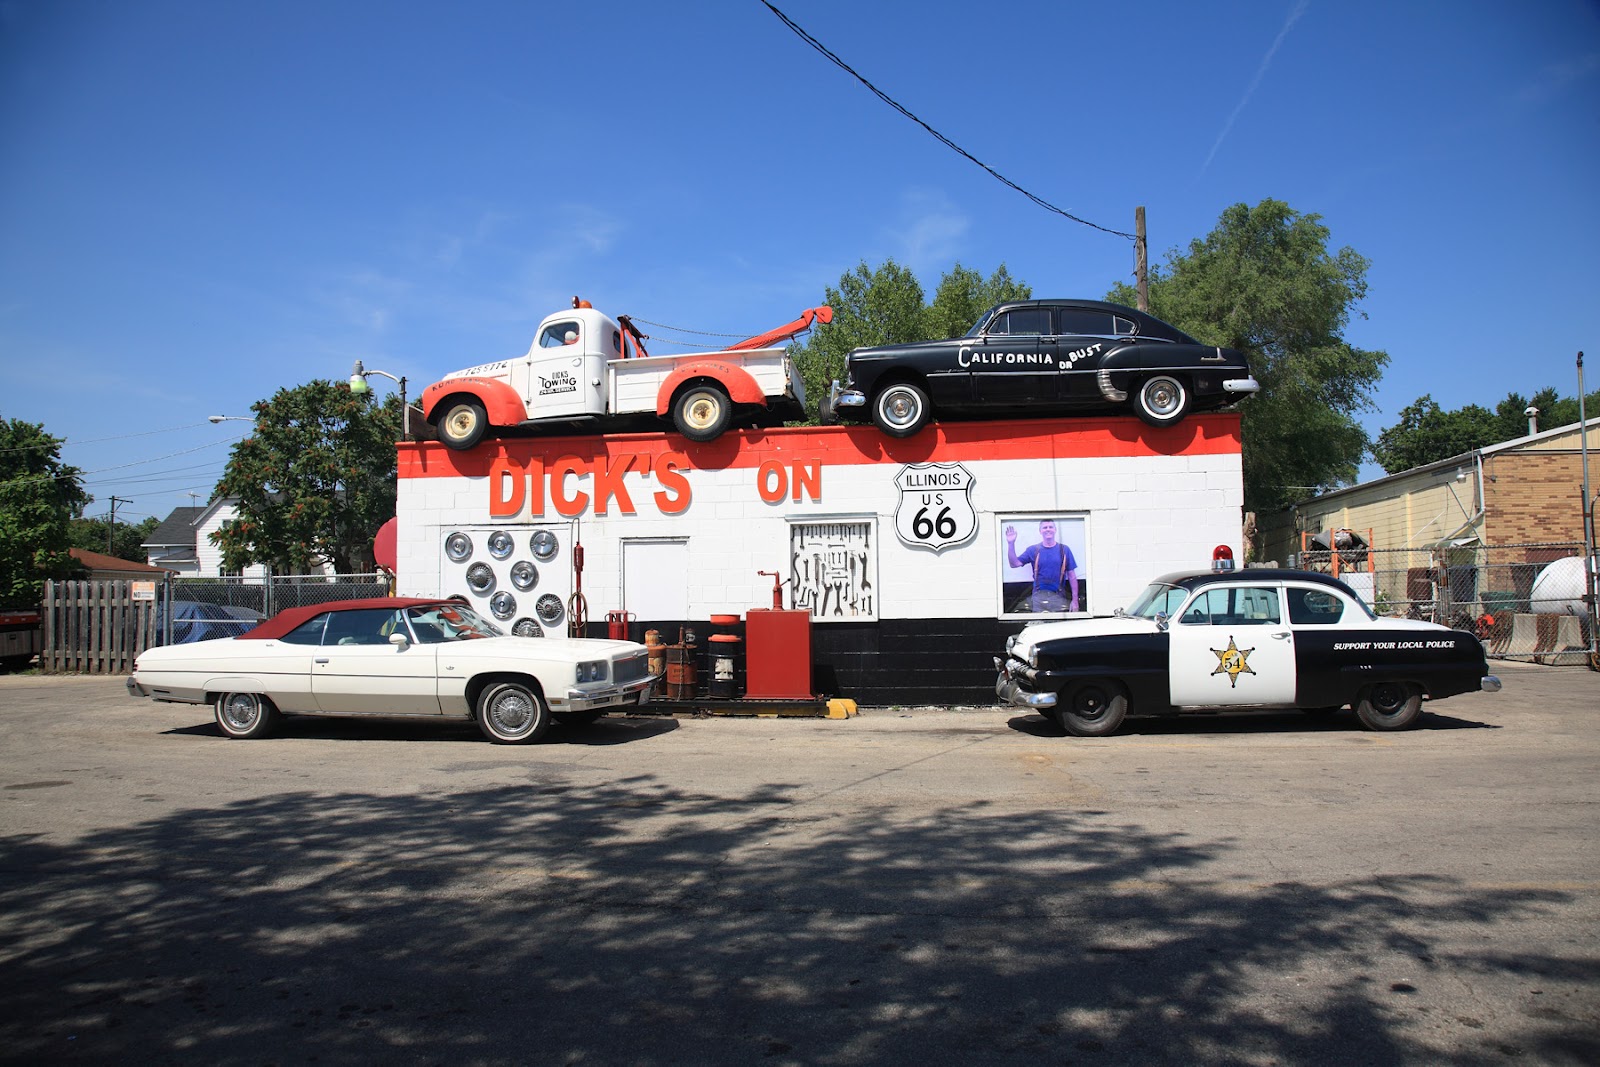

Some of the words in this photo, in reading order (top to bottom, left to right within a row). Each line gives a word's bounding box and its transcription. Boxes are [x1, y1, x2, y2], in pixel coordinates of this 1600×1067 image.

[958, 346, 1053, 368] CALIFORNIA
[1059, 360, 1073, 370] OR
[1068, 343, 1102, 363] BUST
[538, 376, 577, 389] TOWING
[489, 451, 692, 518] DICK'S
[757, 459, 822, 503] ON
[906, 472, 961, 487] ILLINOIS
[912, 506, 957, 540] 66
[1333, 642, 1371, 650] SUPPORT
[1397, 641, 1424, 649] LOCAL
[1425, 640, 1455, 648] POLICE
[1224, 657, 1242, 670] 54
